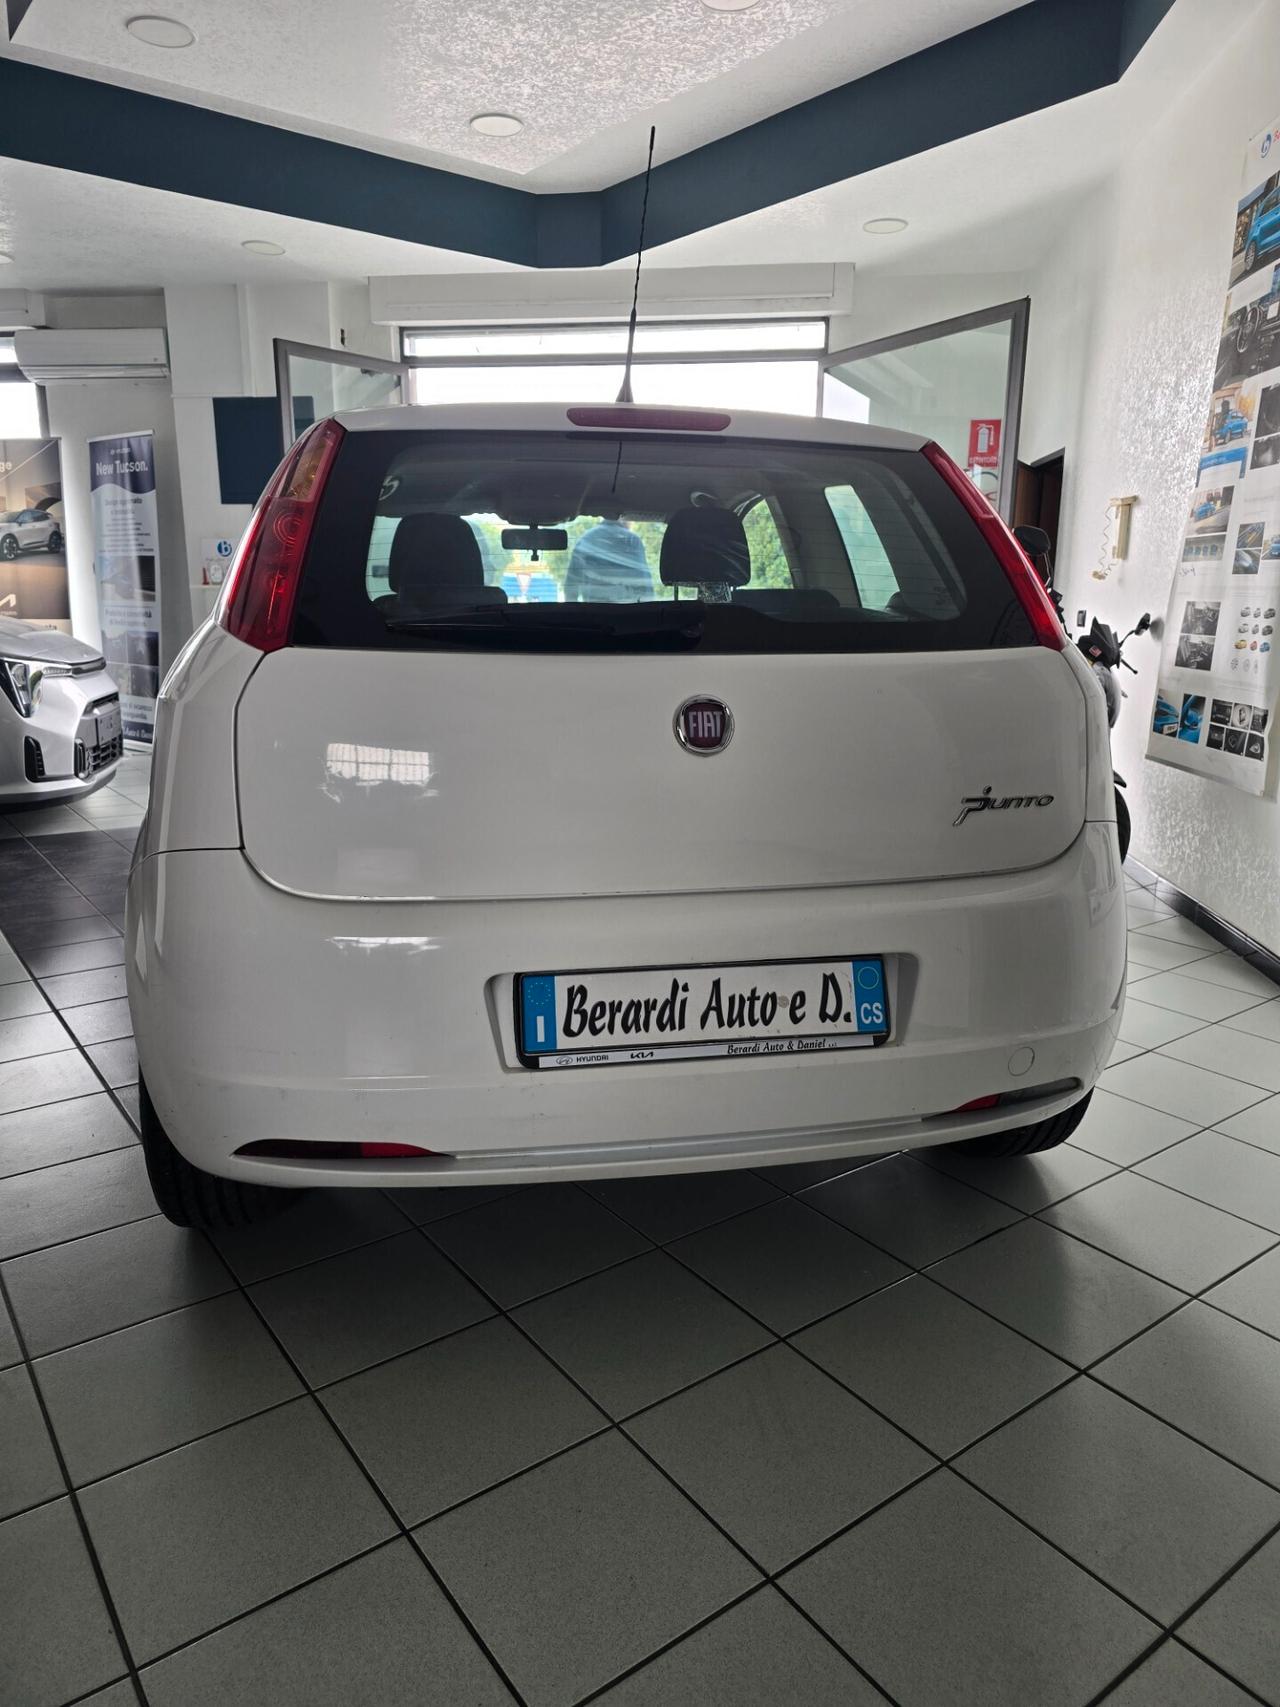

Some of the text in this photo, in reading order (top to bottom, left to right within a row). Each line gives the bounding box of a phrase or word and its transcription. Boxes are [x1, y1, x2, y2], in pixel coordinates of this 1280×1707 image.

[96, 460, 149, 476] New Tucson.
[688, 710, 723, 739] FIAT
[562, 972, 853, 1038] Berardi Auto e D.
[860, 1002, 883, 1025] CS
[535, 1015, 546, 1043] I
[630, 1051, 655, 1059] KIA
[727, 1043, 760, 1055] Berardi
[763, 1041, 784, 1052] Auto
[787, 1041, 794, 1050] &
[797, 1039, 826, 1050] Daniel
[576, 1054, 609, 1062] HYUNDAI
